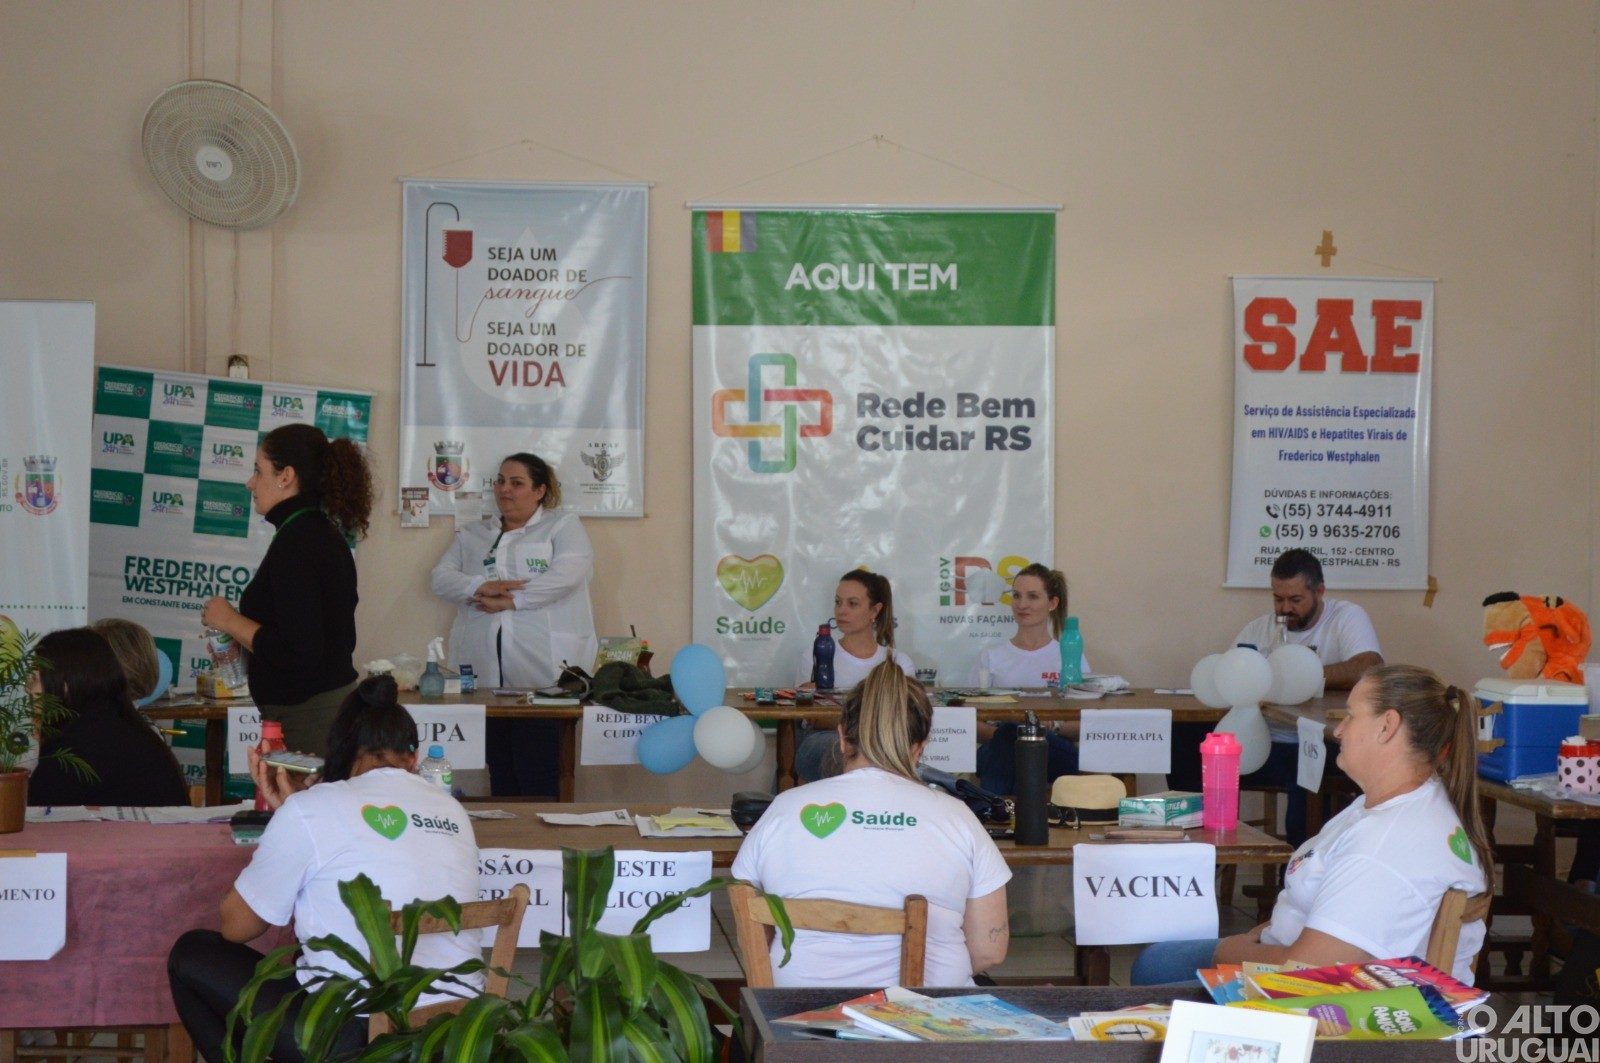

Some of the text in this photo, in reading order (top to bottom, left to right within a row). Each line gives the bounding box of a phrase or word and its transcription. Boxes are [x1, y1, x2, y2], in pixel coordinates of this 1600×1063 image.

[488, 247, 557, 261] SEJA UM
[487, 268, 587, 283] DOADOR DE
[784, 263, 958, 290] AQUI TEM
[484, 284, 577, 318] sangue
[487, 322, 556, 336] SEJA UM
[1243, 297, 1422, 373] SAE
[487, 342, 587, 358] DOADOR DE
[489, 360, 566, 388] VIDA
[164, 383, 195, 398] UPA
[273, 396, 303, 410] UPA
[857, 392, 1035, 418] Rede Bem
[1244, 404, 1416, 420] Serviço de Assistência Especializada
[103, 431, 134, 446] UPA
[856, 424, 1032, 451] Cuidar RS
[1251, 427, 1408, 442] em HIV/AIDS e Hepatites Virais de
[213, 443, 244, 458] UPA
[1279, 450, 1380, 464] Frederico Westphalen
[153, 491, 184, 506] UPA
[1264, 489, 1392, 500] DÚVIDAS E INFORMAÇÕES:
[1283, 503, 1392, 519] (55) 3744-4911
[1275, 524, 1400, 540] (55) 9 9635-2706
[1260, 546, 1281, 555] RUA
[1355, 548, 1394, 556] CENTRO
[124, 555, 250, 585] FREDERICO
[526, 558, 548, 568] UPA
[1387, 559, 1400, 567] RS
[135, 597, 180, 608] CONSTANTE
[181, 601, 204, 611] DESEN
[716, 616, 786, 634] Saúde
[940, 615, 974, 624] NOVAS
[596, 713, 631, 723] REDE
[240, 732, 258, 741] DO
[603, 729, 643, 738] CUIDA
[1086, 732, 1163, 741] FISIOTERAPIA
[411, 814, 459, 833] Saúde
[851, 810, 917, 826] Saúde
[616, 860, 677, 877] ESTE
[1084, 875, 1205, 898] VACINA
